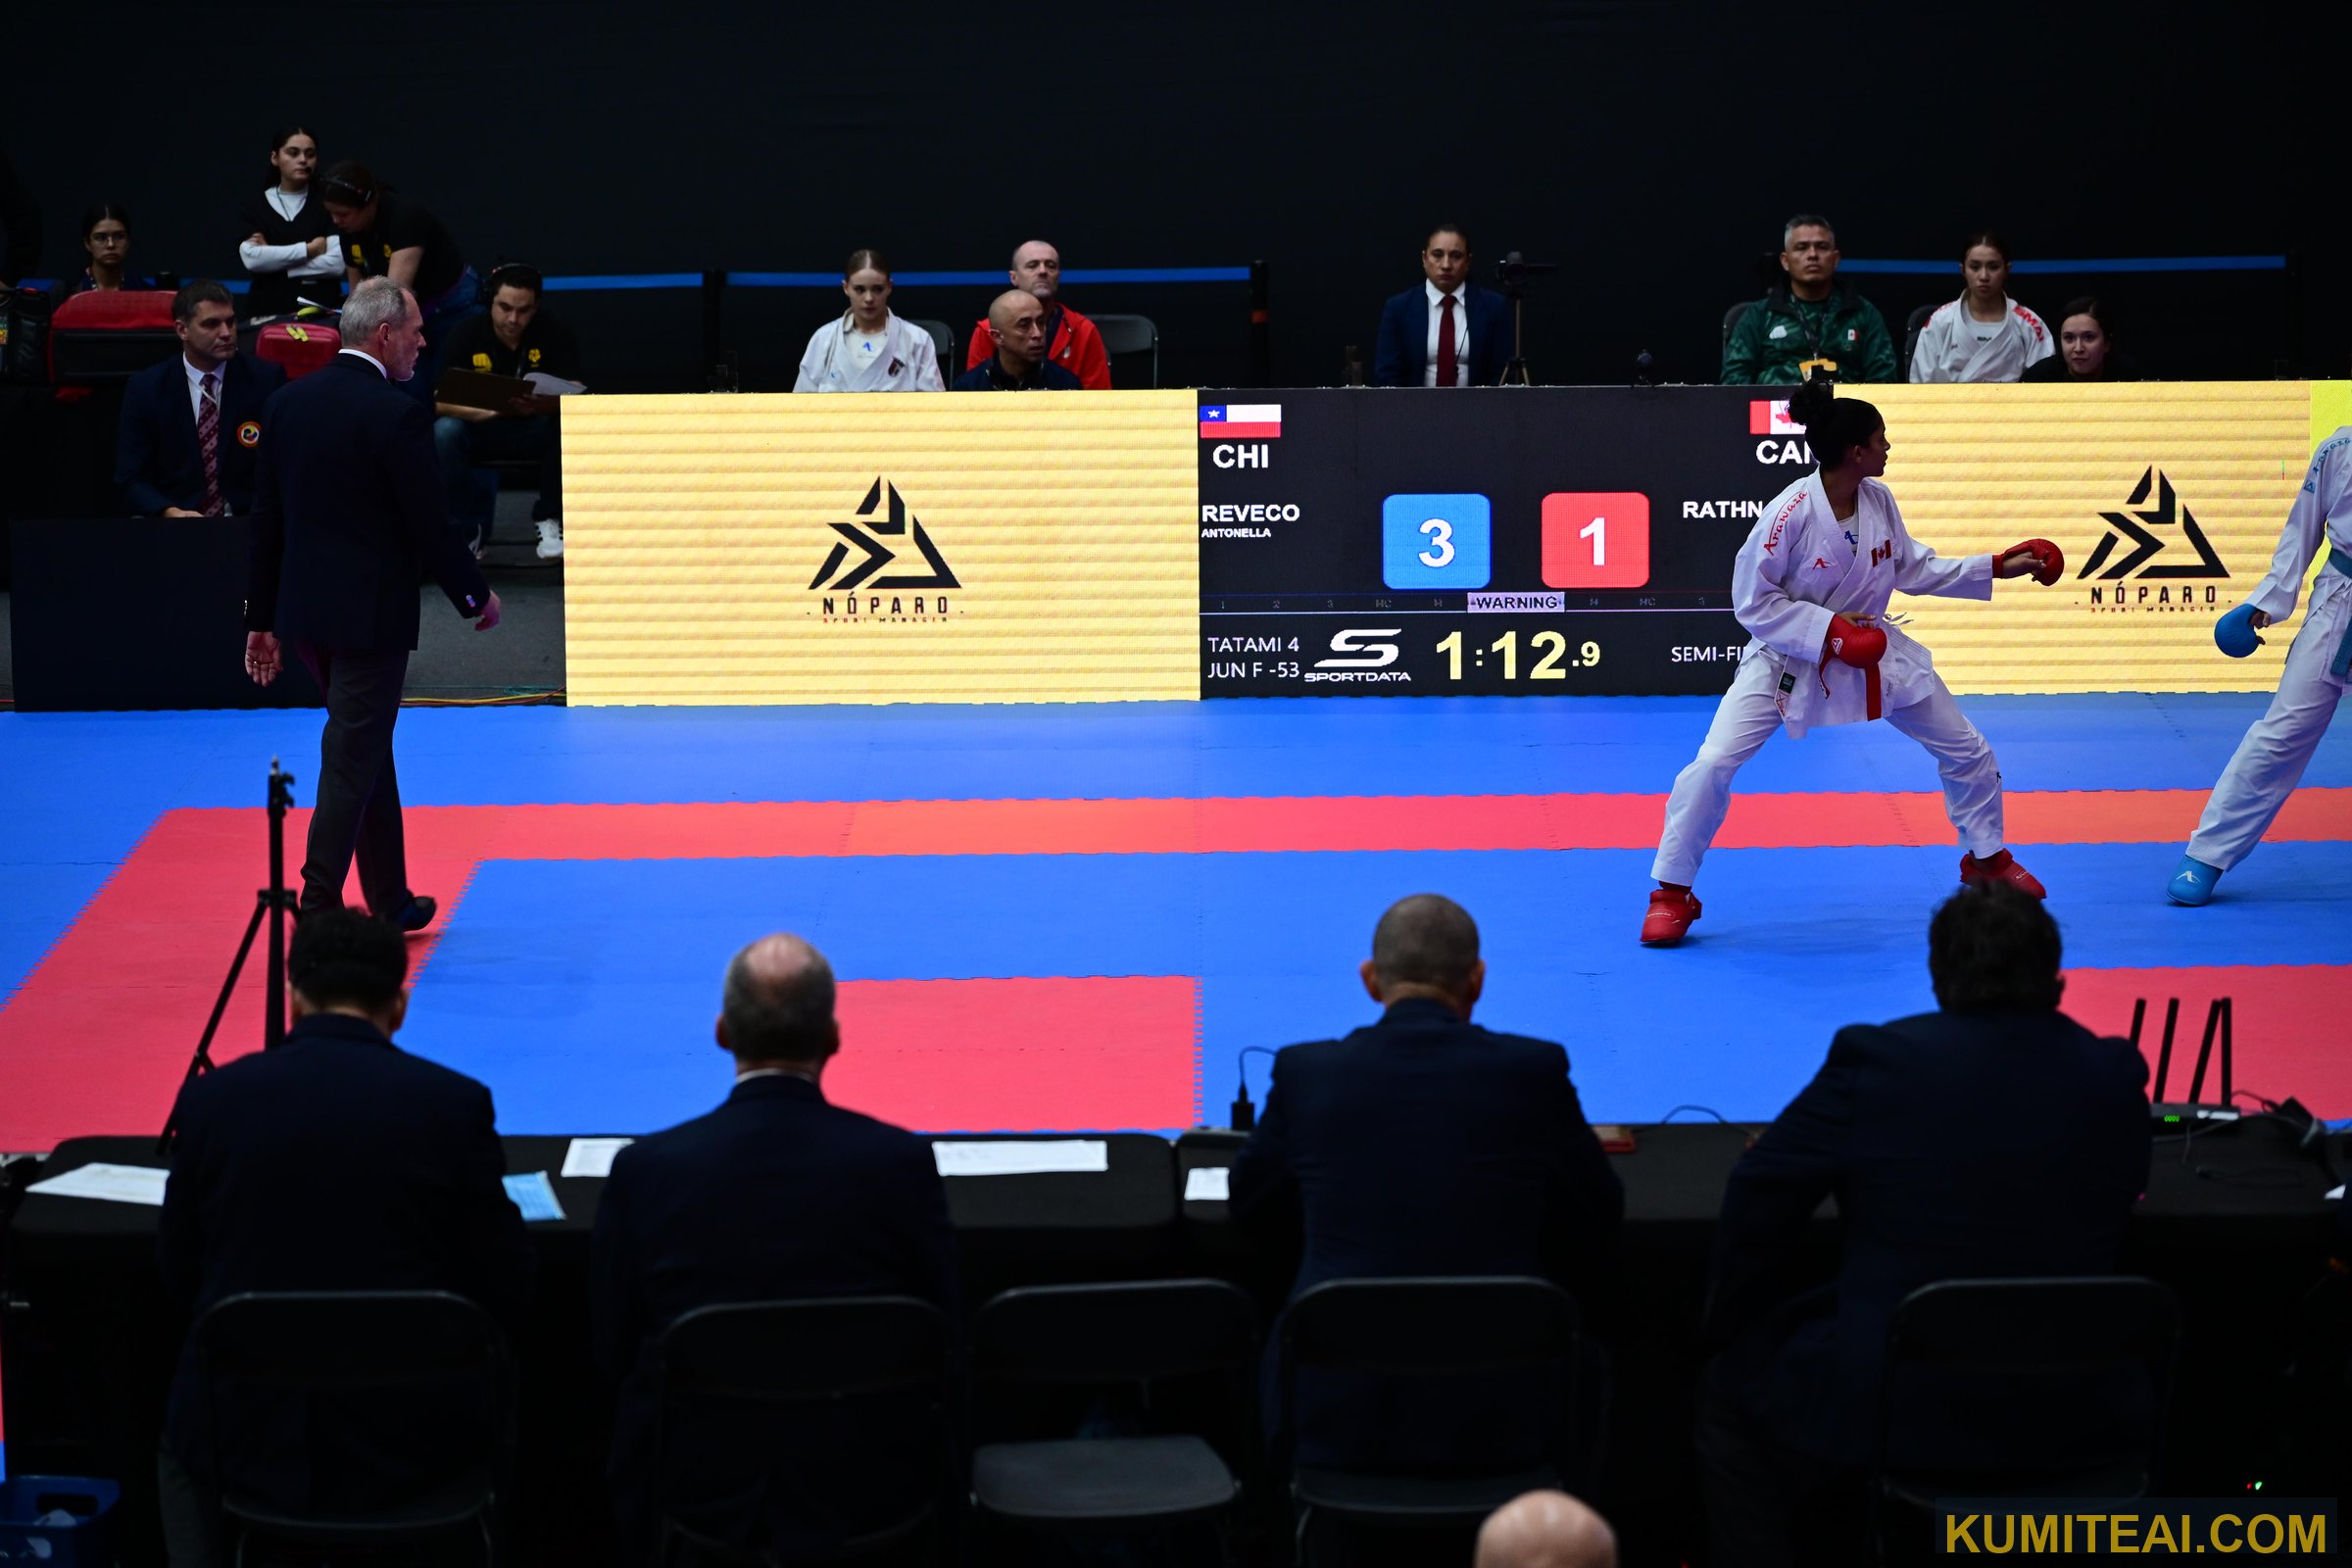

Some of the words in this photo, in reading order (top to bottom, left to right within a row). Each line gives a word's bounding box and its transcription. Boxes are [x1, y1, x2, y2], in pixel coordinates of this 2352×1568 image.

[1212, 444, 1269, 468] CHI
[1201, 504, 1300, 522] REVECO
[1200, 527, 1272, 538] ANTONELLA
[1764, 491, 1808, 557] Arawaza
[1418, 518, 1455, 567] 3
[1580, 516, 1605, 565] 1
[823, 591, 948, 614] NÓPARO
[1476, 596, 1558, 609] WARNING
[2090, 580, 2216, 605] NÓPARO
[1207, 637, 1281, 653] TATAMI
[1288, 637, 1299, 652] 4
[1436, 630, 1600, 680] 1:12.9
[1671, 646, 1745, 662] SEMI-FI
[1207, 662, 1245, 678] JUN
[1252, 662, 1262, 677] F
[1269, 662, 1299, 677] -53
[1303, 672, 1411, 682] SPORTDATA
